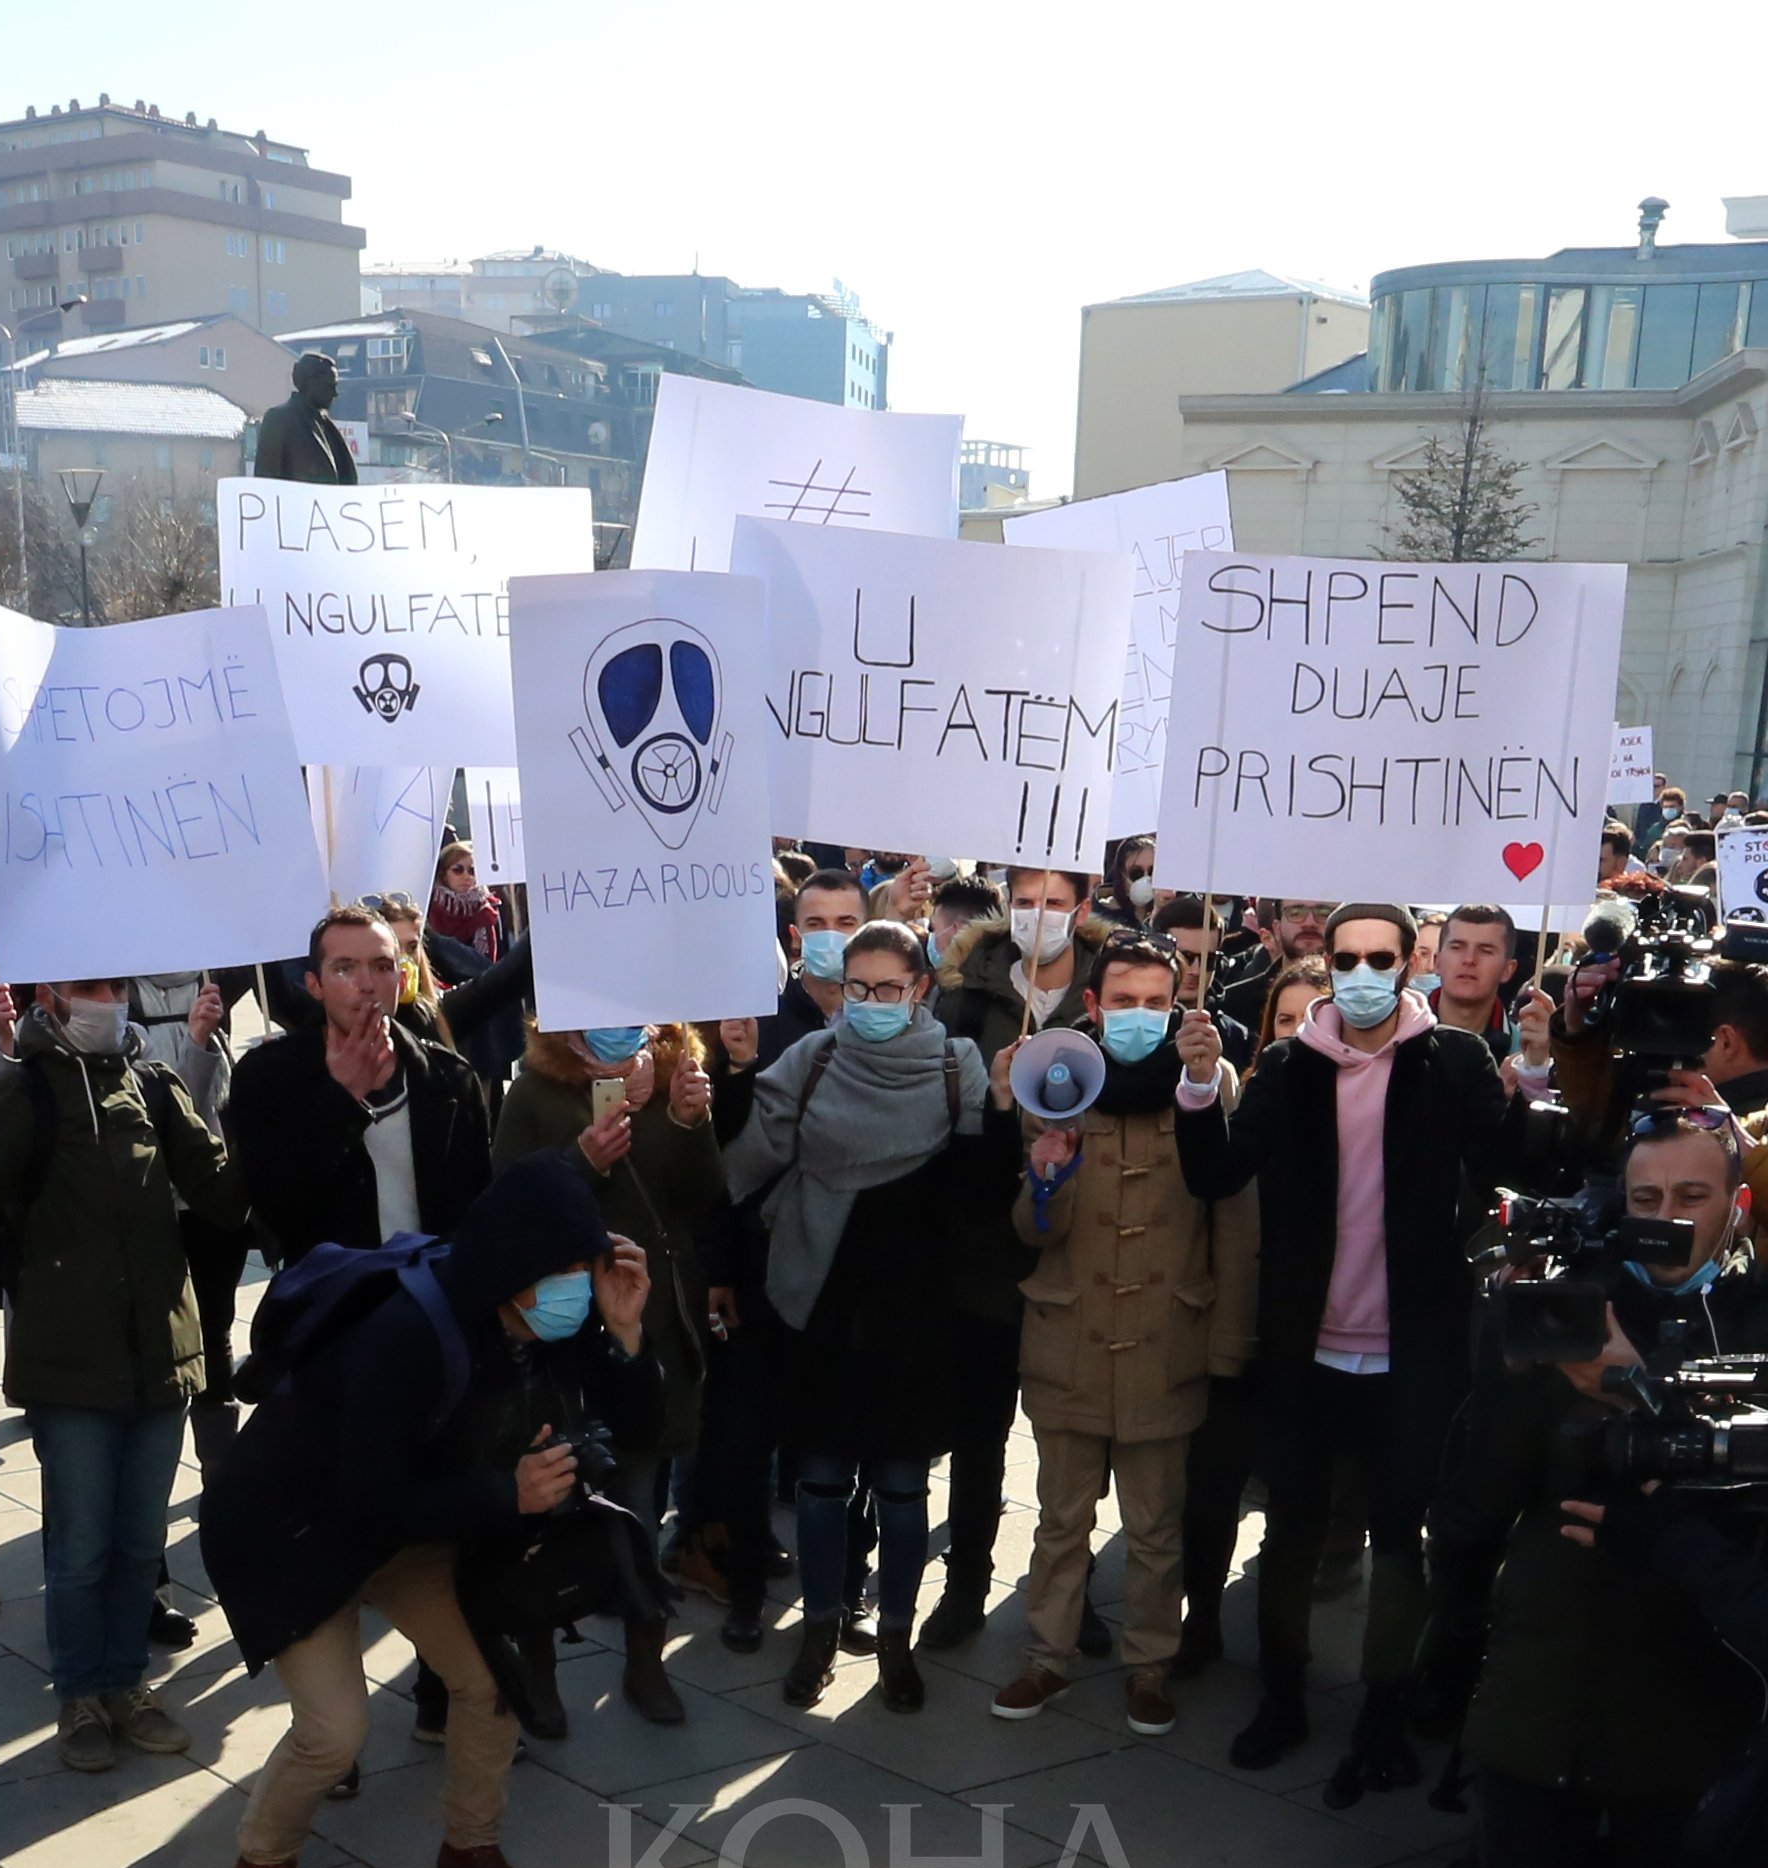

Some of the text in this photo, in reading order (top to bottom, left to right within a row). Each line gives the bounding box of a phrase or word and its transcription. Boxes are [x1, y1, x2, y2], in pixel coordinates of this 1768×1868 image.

[853, 587, 916, 668] U
[1200, 565, 1539, 648] SHPEND
[763, 669, 1120, 773] NGULFATËM
[1290, 661, 1481, 723] DUAJE
[1193, 745, 1580, 826] PRISHTINËN
[540, 862, 767, 915] HAZARDOUS
